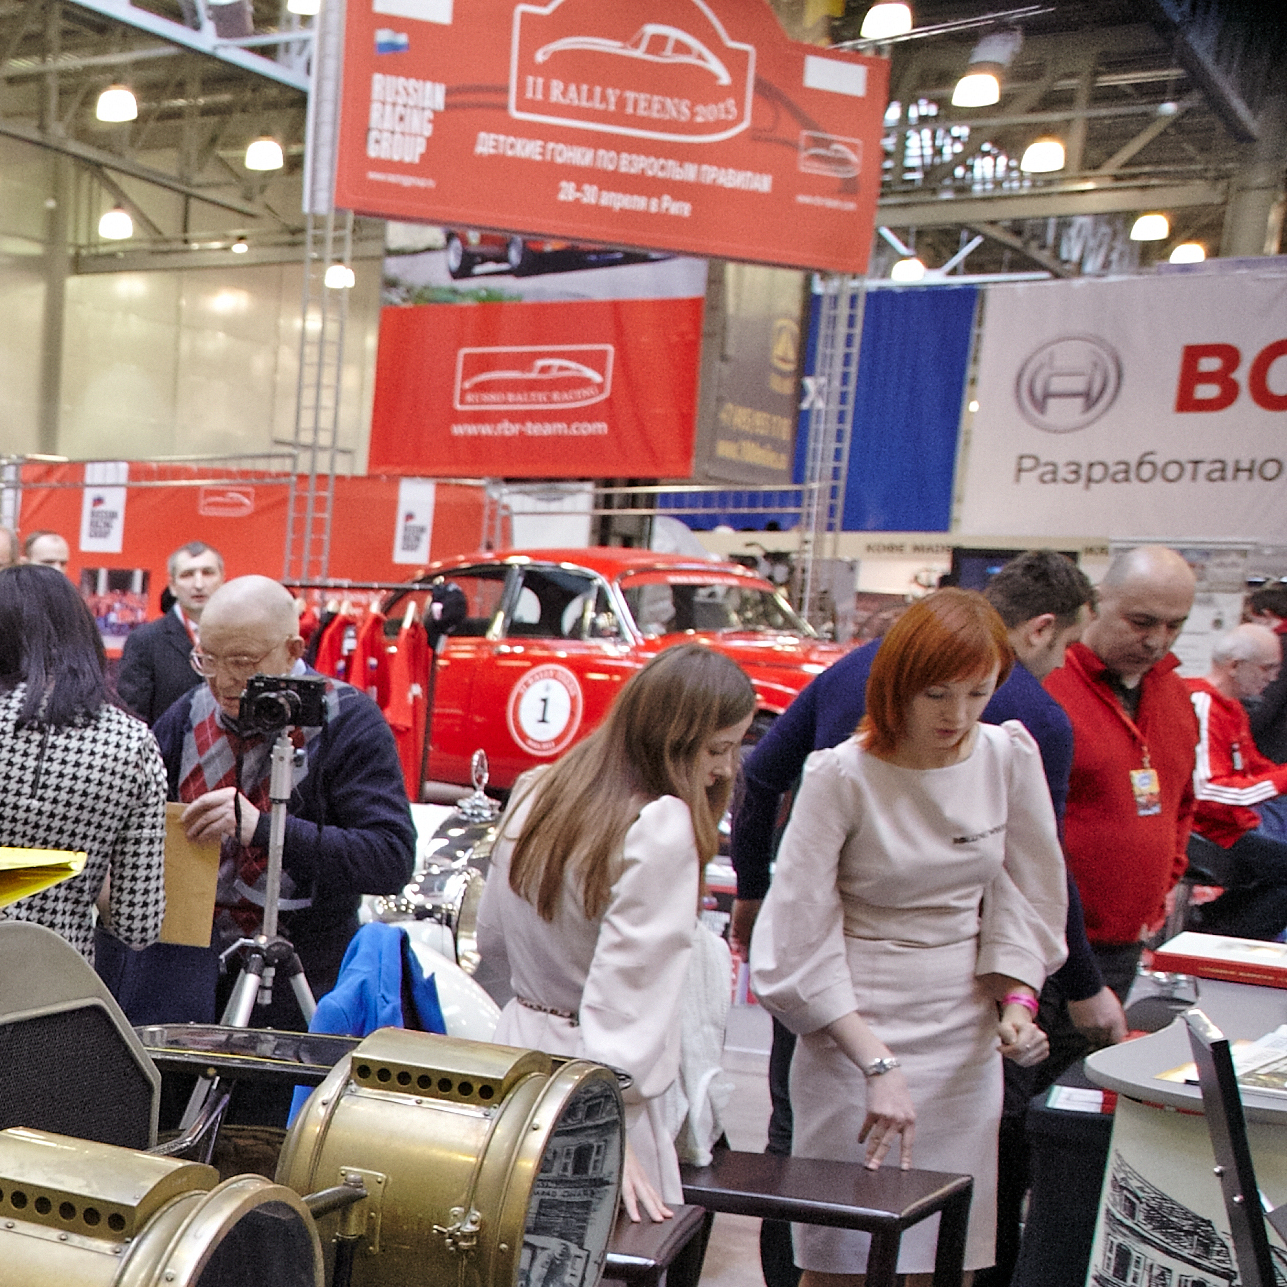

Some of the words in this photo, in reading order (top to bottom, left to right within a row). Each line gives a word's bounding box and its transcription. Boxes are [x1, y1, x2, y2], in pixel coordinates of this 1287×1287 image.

[371, 72, 446, 112] RUSSIAN
[525, 75, 544, 100] II
[549, 79, 620, 111] RALLY
[624, 89, 691, 122] TEENS
[369, 102, 434, 138] RACING
[366, 129, 427, 164] GROUP
[475, 131, 543, 161] ДЕТСКИЕ
[545, 141, 595, 168] ГОНКИ
[595, 149, 619, 171] ПО
[618, 151, 699, 182] ВЗРОСЛЫМ
[699, 163, 773, 193] ПРАВИЛАМ
[451, 418, 609, 437] www.rbr-team.com
[1014, 451, 1284, 490] Разработано
